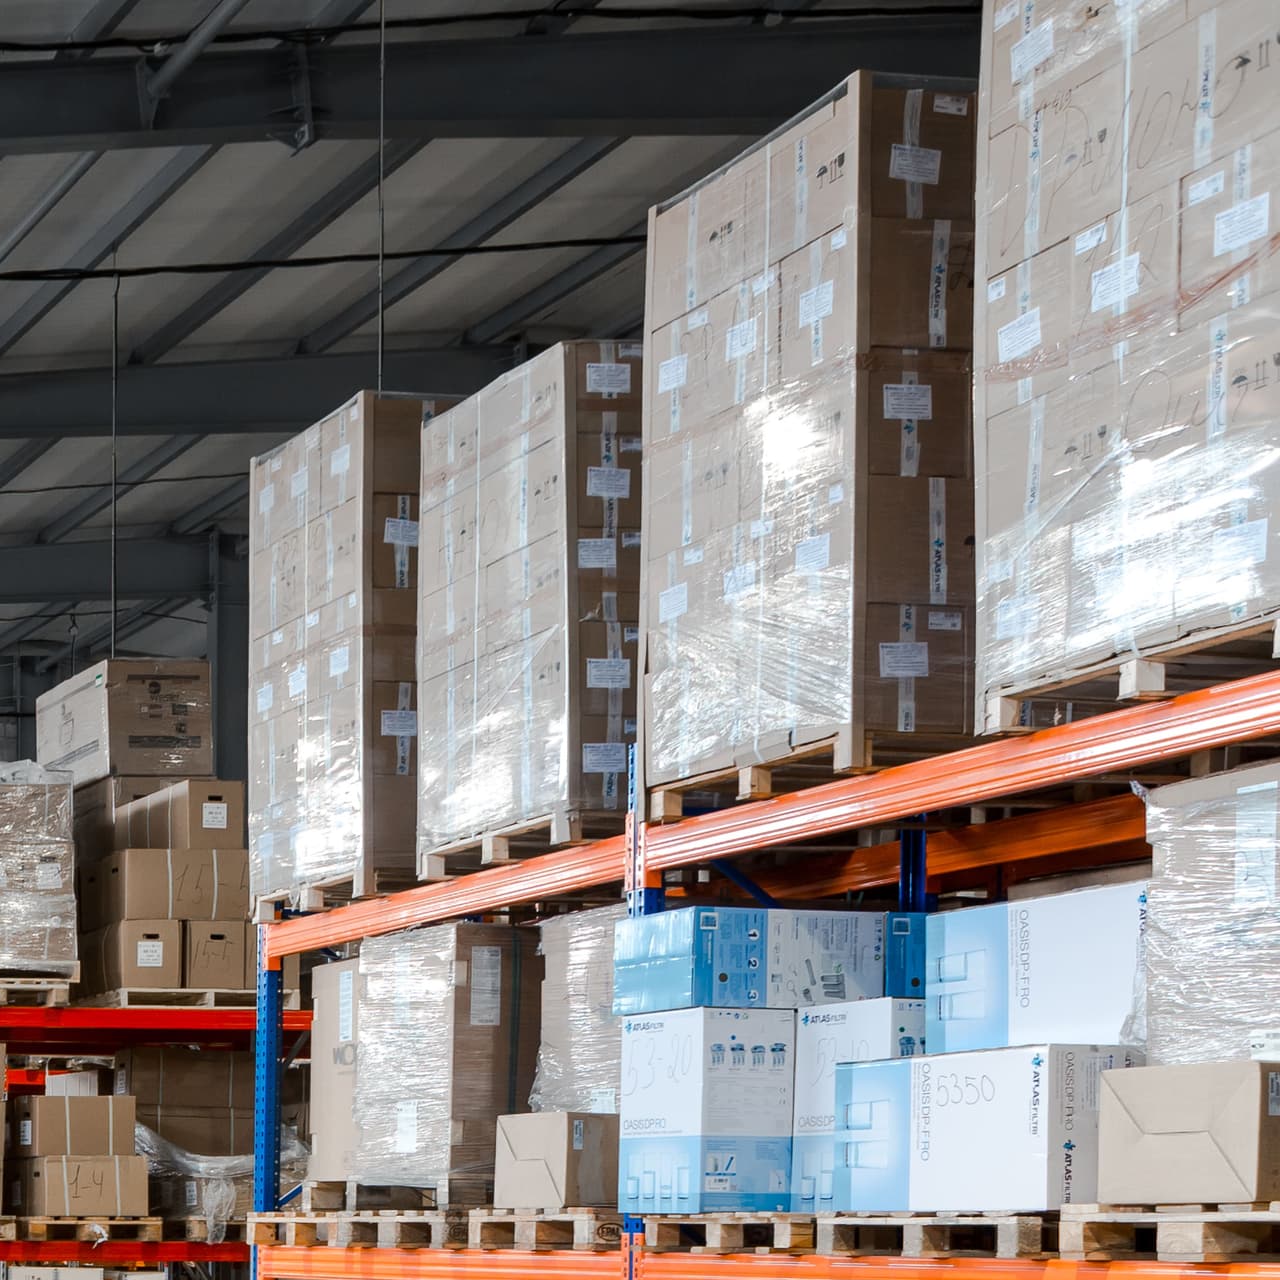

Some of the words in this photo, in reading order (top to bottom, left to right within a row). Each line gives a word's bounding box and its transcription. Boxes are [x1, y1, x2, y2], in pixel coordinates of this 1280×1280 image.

[810, 1014, 830, 1024] ATLAS
[936, 1073, 996, 1107] 5350
[1032, 1071, 1040, 1106] ATLAS
[1065, 1153, 1073, 1181] ATLAS
